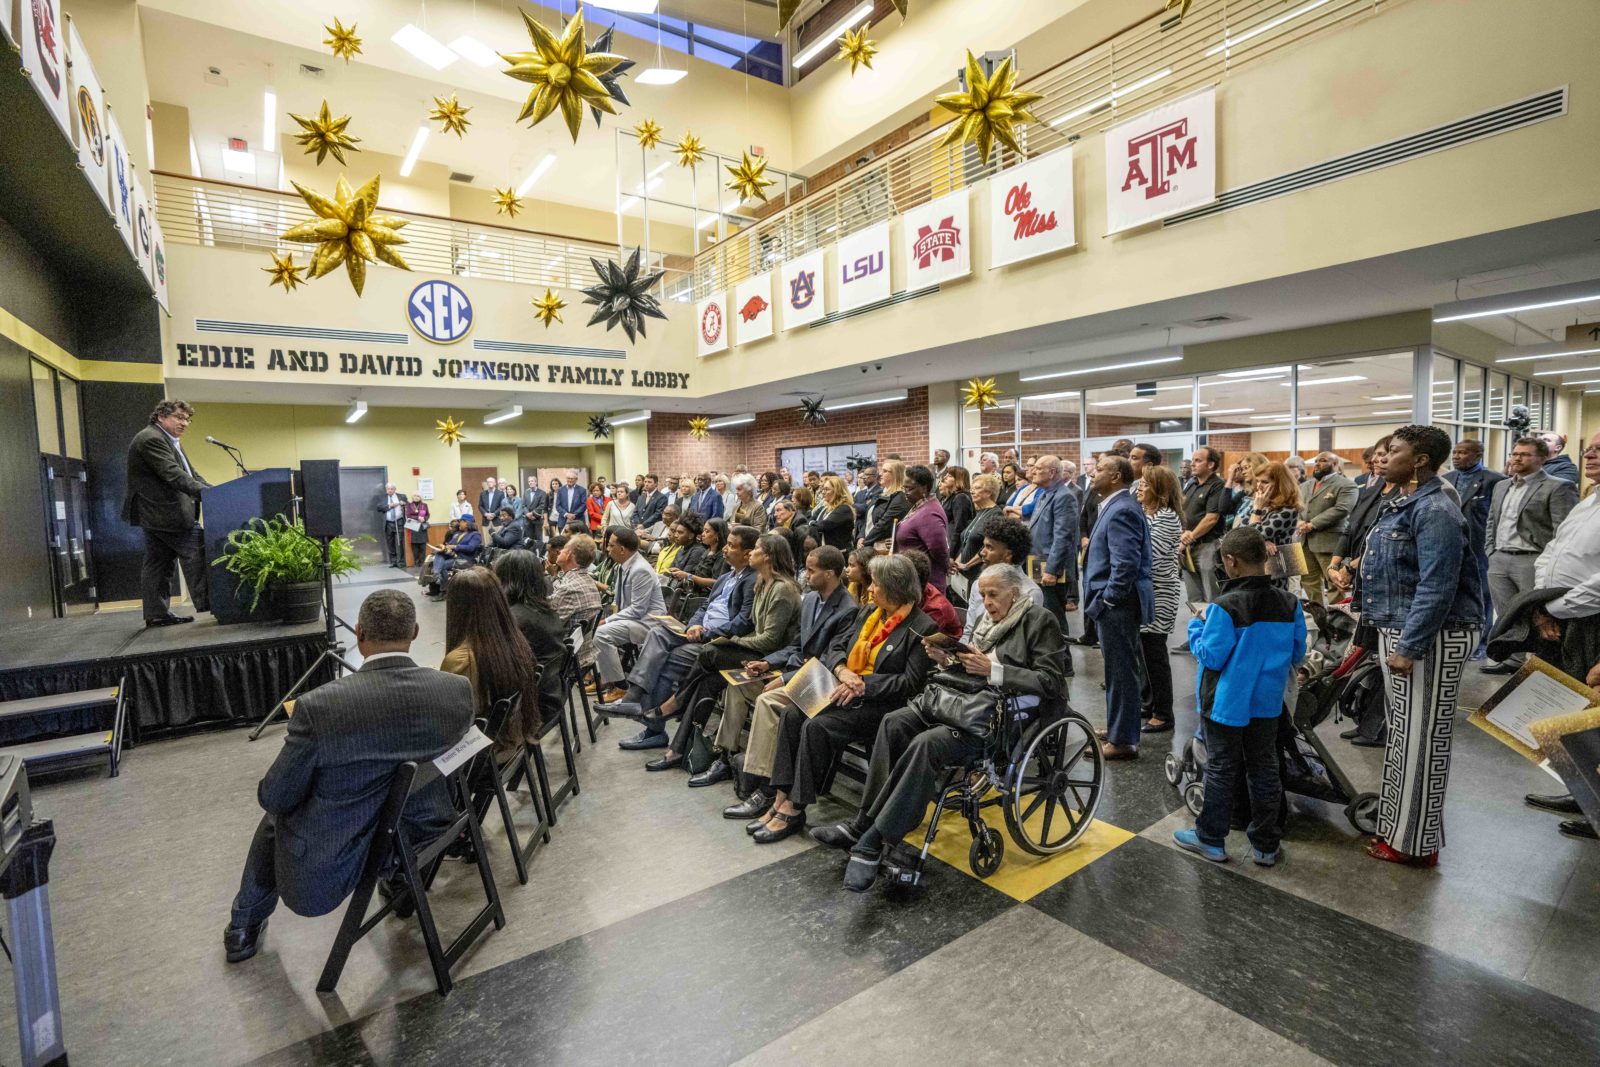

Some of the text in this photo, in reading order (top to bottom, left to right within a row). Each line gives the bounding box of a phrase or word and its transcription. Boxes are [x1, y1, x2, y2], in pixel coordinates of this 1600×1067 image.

[1004, 181, 1032, 215] Ole
[1013, 207, 1058, 241] Miss
[920, 232, 953, 254] STATE
[842, 251, 884, 284] LSU
[411, 283, 469, 339] SEC
[176, 343, 691, 390] EDIE AND DAVID JOHNSON FAMILY LOBBY
